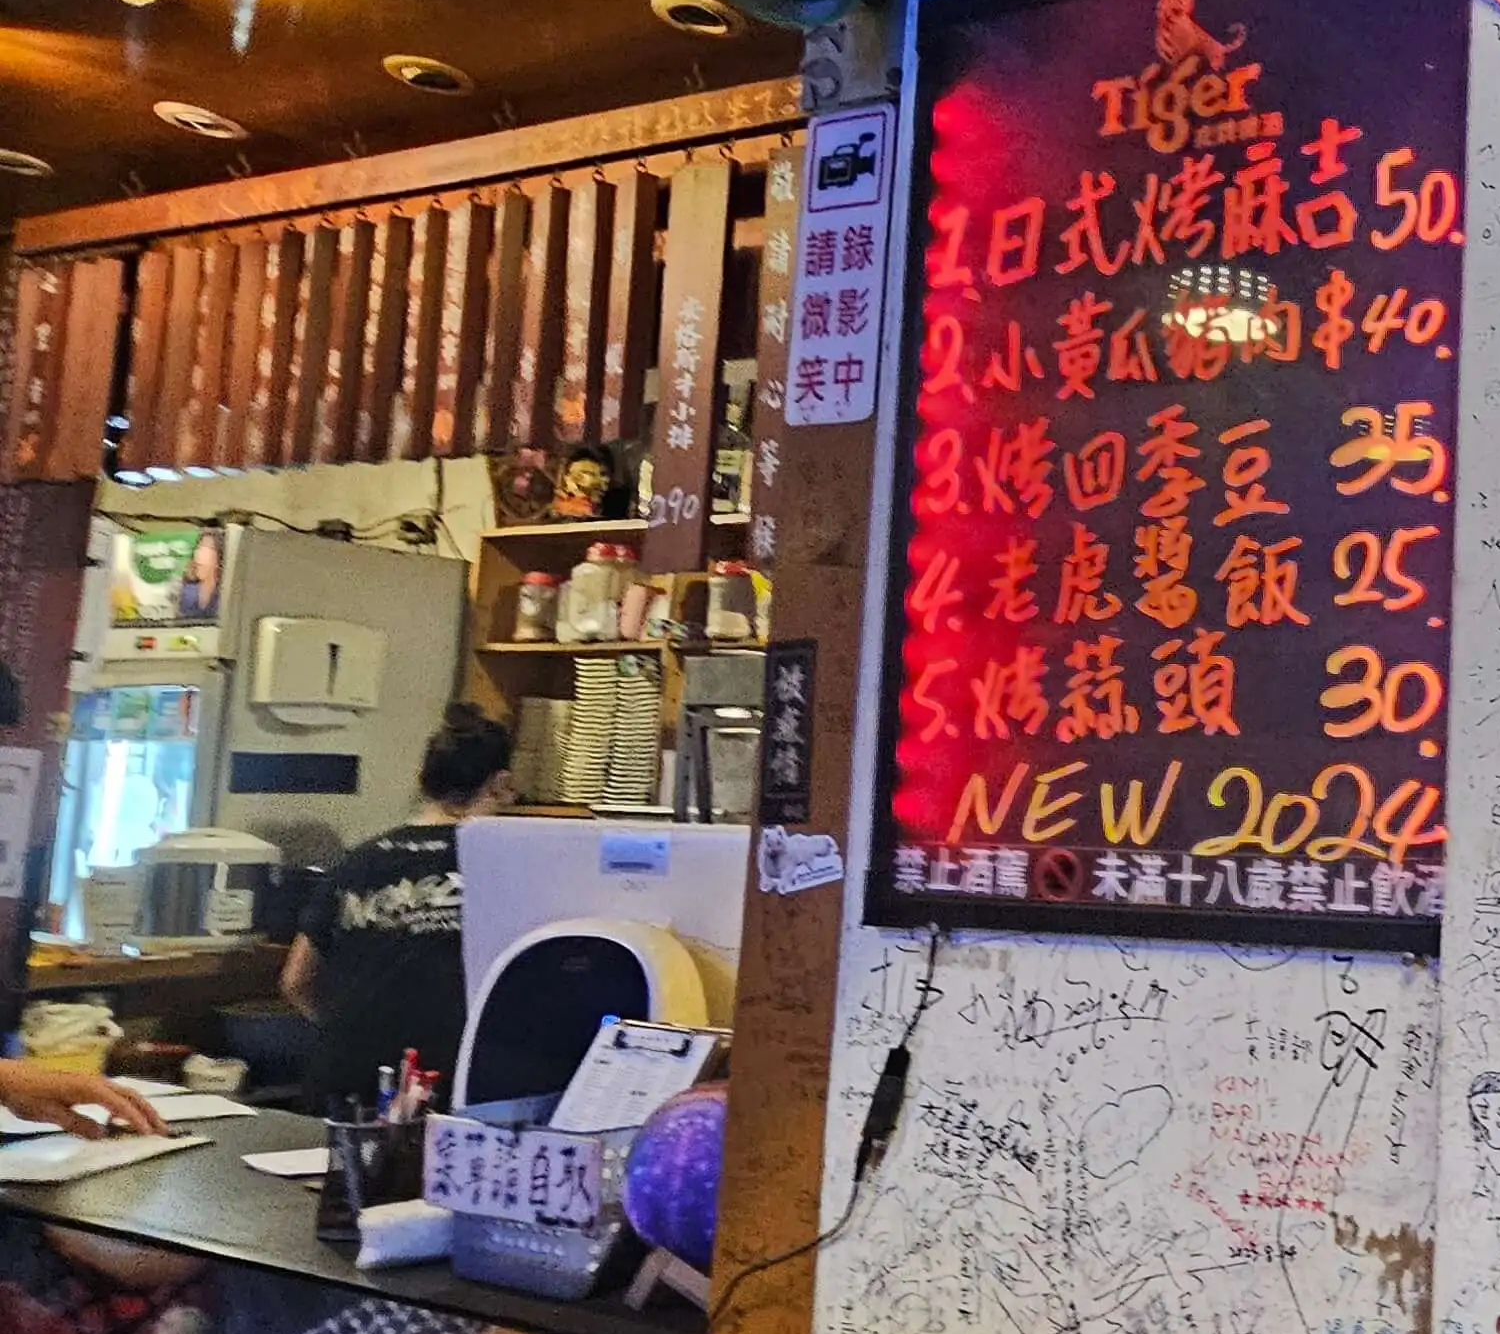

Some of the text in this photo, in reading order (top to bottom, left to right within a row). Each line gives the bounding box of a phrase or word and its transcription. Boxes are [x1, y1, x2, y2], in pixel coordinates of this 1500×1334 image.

[1091, 61, 1263, 154] Tiger
[794, 229, 839, 403] 請微笑
[833, 224, 875, 403] 錄影中
[948, 759, 1451, 865] NEW 2024
[894, 843, 1030, 900] 禁止酒駕
